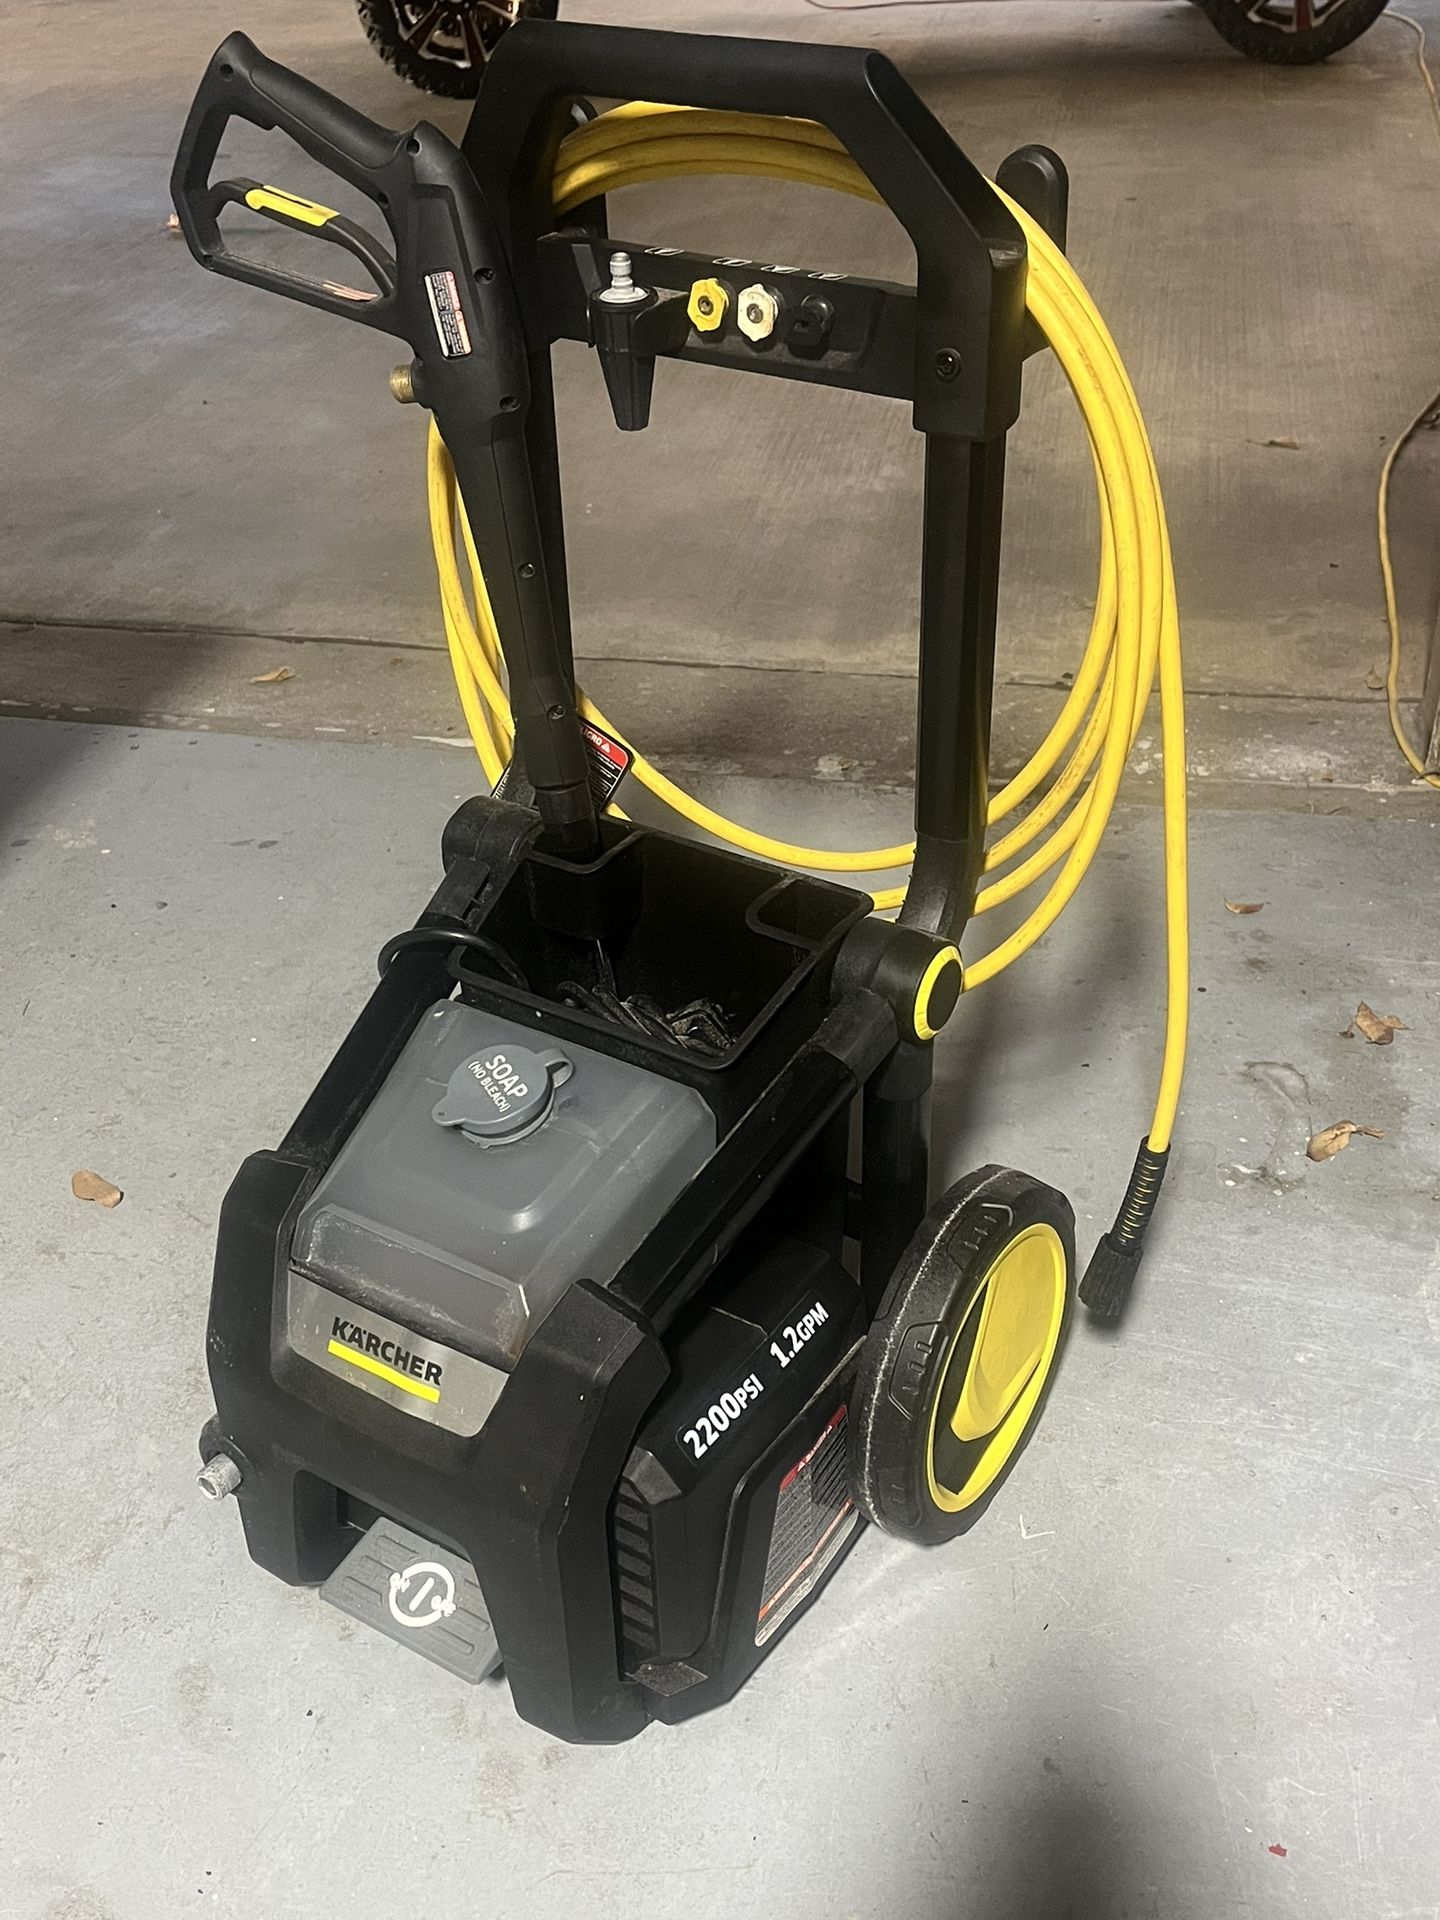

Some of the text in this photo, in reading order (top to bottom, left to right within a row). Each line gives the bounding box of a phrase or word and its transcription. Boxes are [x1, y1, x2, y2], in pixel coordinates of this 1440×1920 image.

[468, 1061, 512, 1113] (NO BLEACH)
[485, 1054, 528, 1097] SOAP
[332, 1316, 443, 1386] KÄRCHER
[683, 1373, 764, 1459] 2200PSI
[769, 1301, 829, 1368] 1.2GPM
